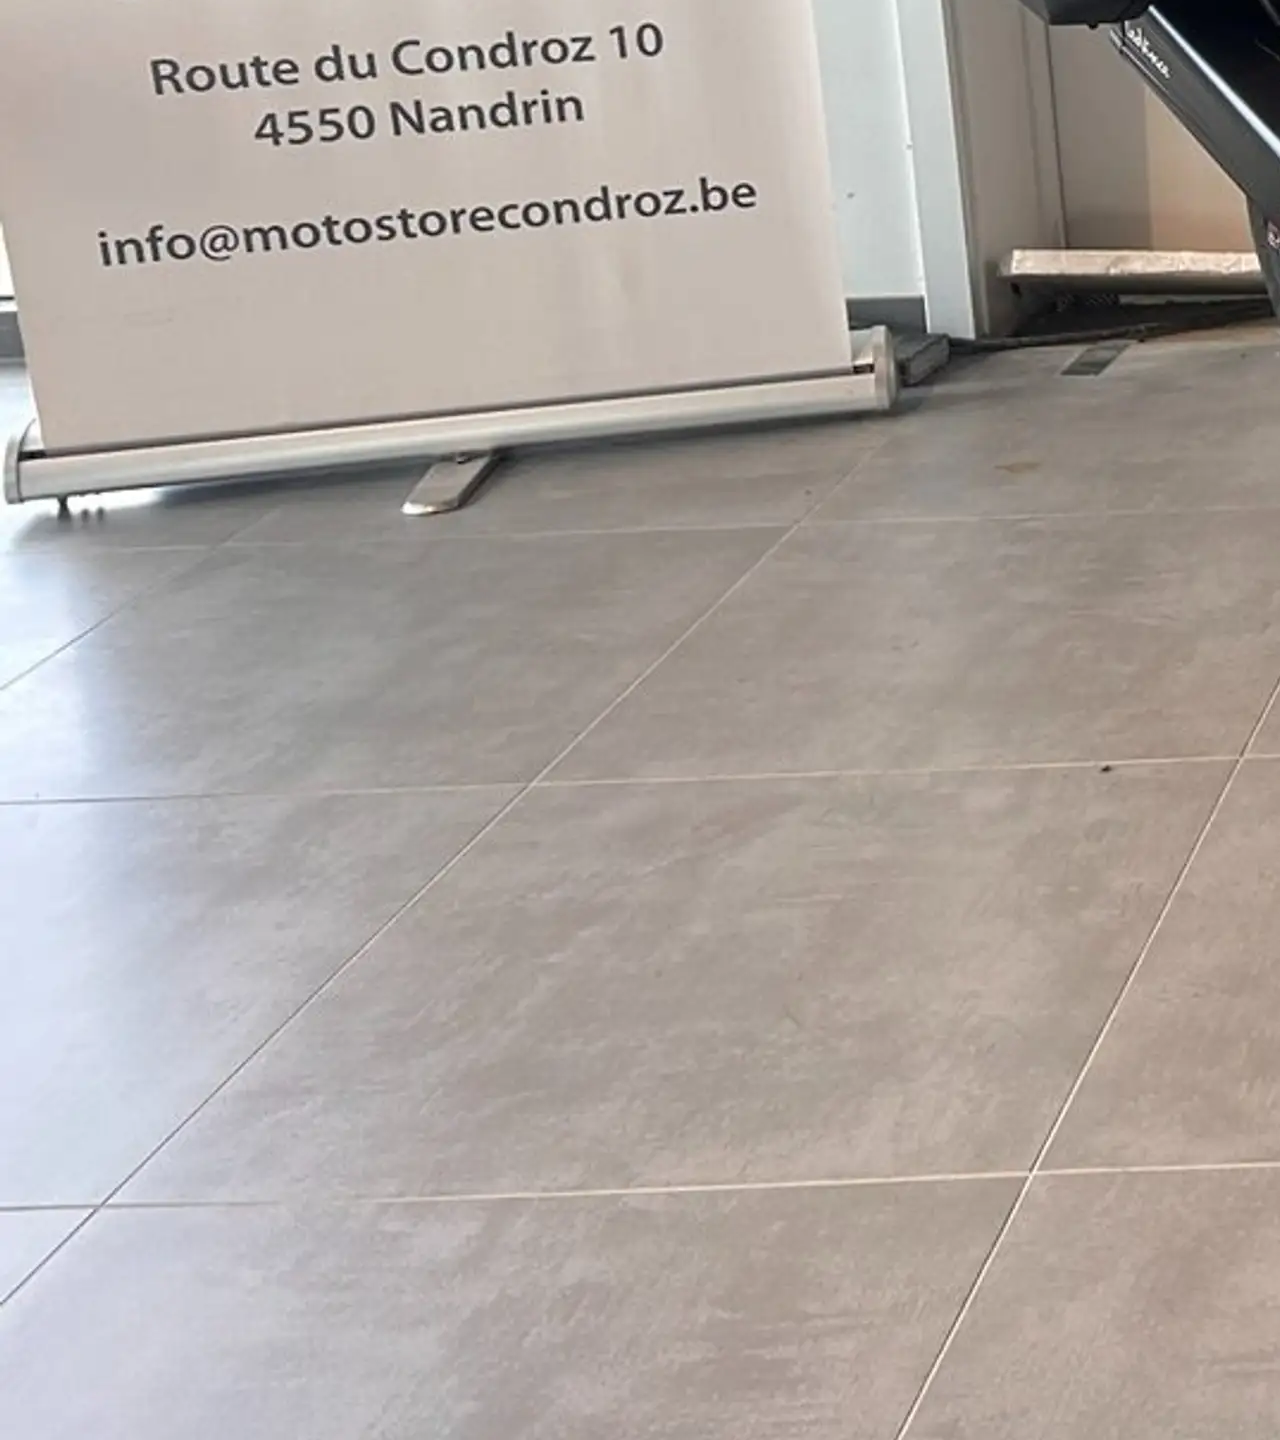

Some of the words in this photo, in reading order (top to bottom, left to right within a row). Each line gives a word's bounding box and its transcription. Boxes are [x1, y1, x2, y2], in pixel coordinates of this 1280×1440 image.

[150, 55, 300, 96] Route
[314, 44, 378, 82] du
[391, 32, 595, 76] Condroz
[610, 22, 664, 59] 10
[253, 105, 376, 146] 4550
[390, 90, 585, 137] Nandrin
[97, 178, 758, 267] info@motostorecondroz.be
